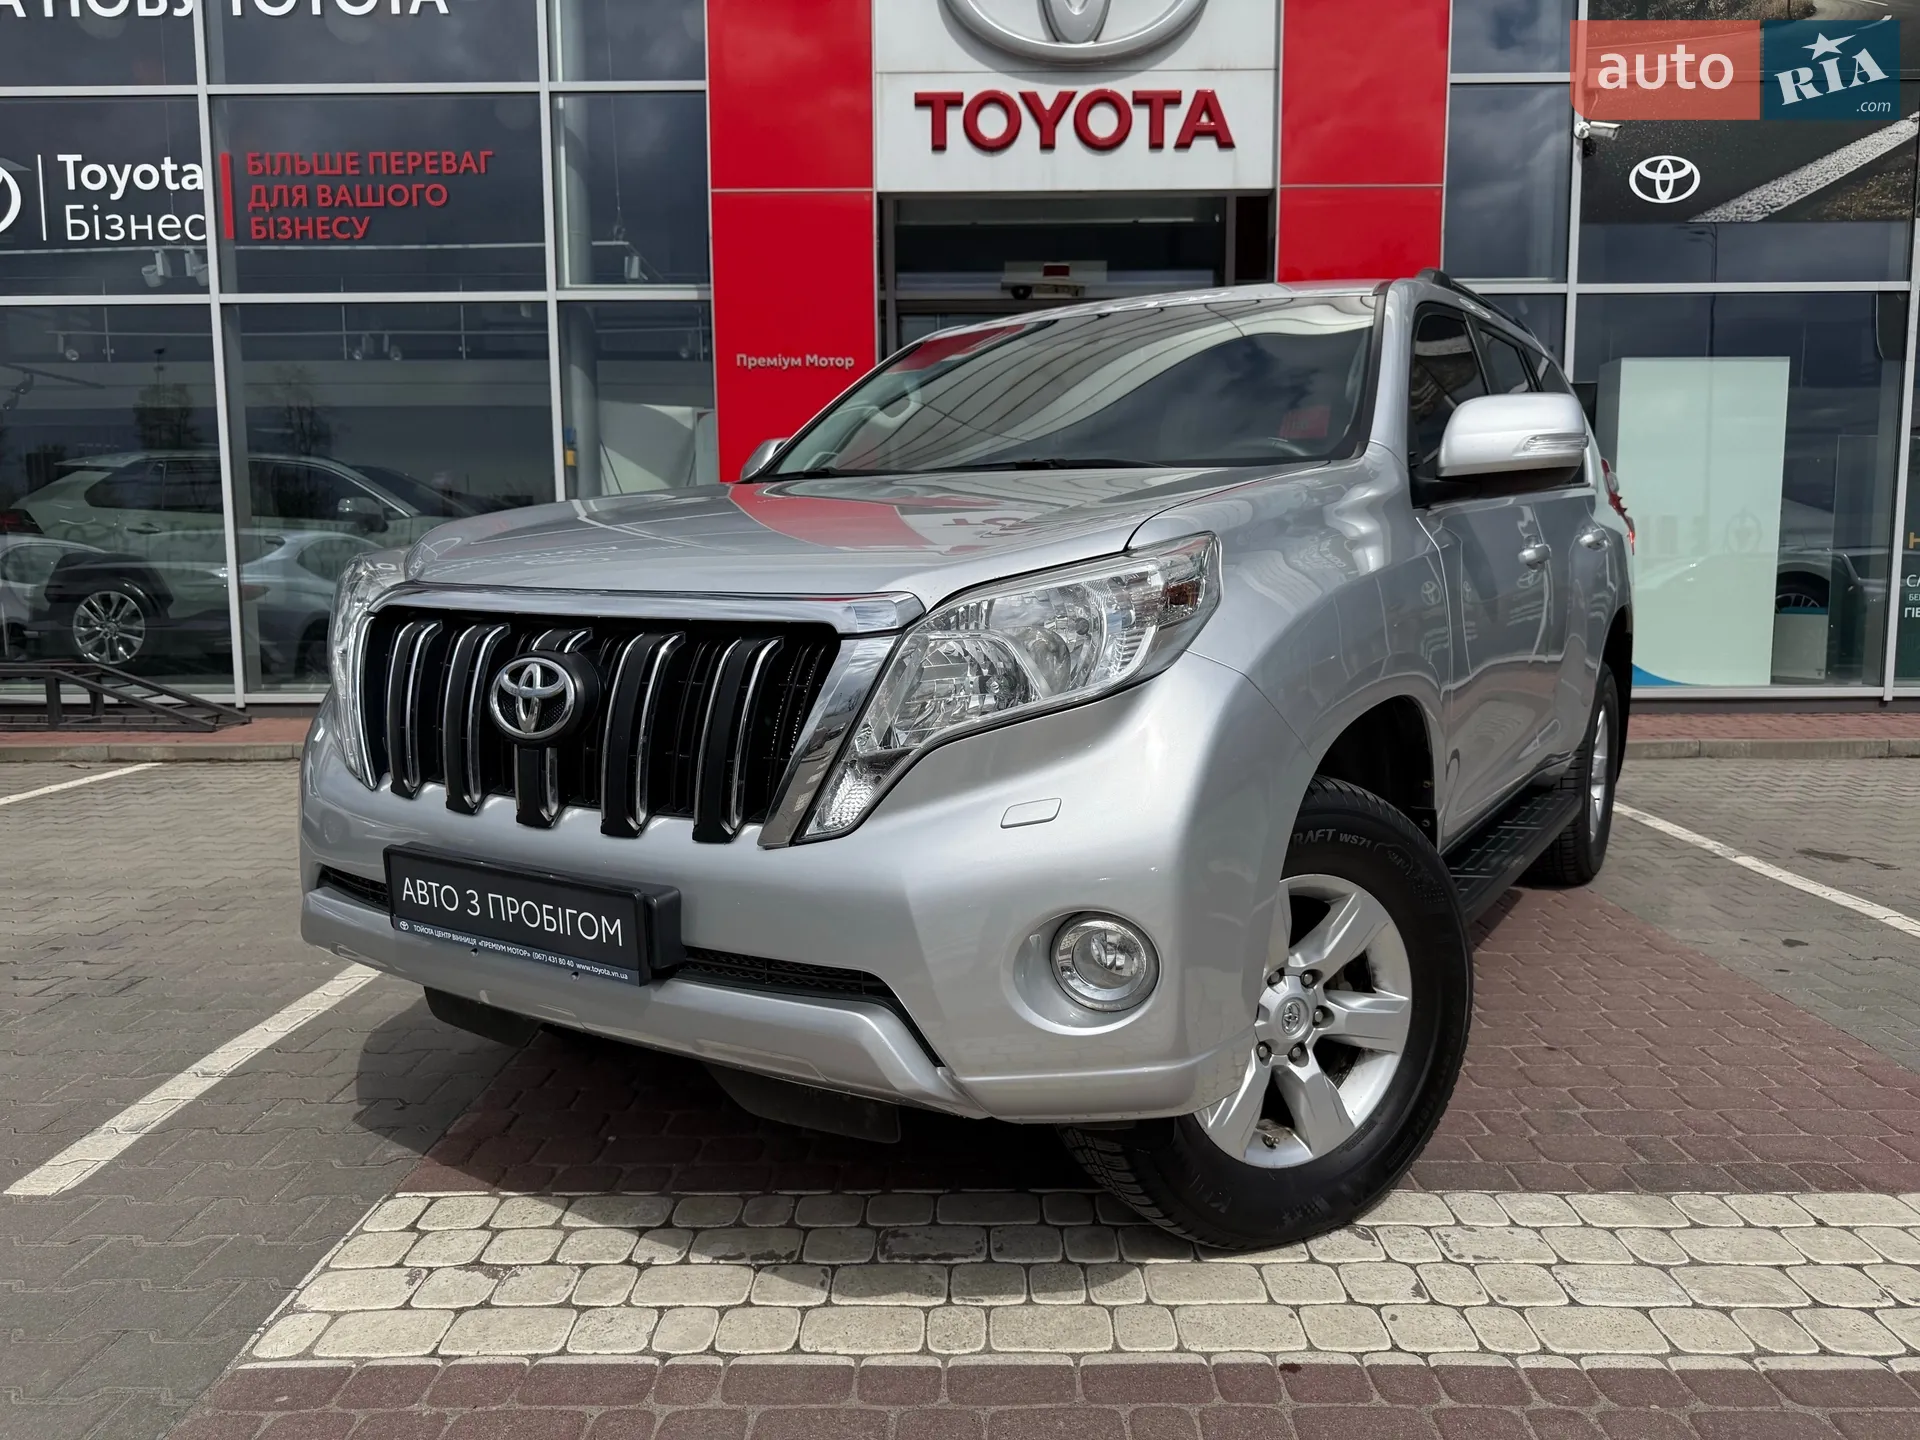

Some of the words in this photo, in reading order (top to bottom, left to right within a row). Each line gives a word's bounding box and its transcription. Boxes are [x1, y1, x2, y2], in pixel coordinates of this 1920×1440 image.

[914, 89, 1236, 152] TOYOTA
[57, 154, 204, 200] Toyota
[246, 151, 361, 176] БІЛЬШЕ
[368, 150, 493, 175] ПЕРЕВАГ
[248, 184, 309, 212] ДЛЯ
[316, 183, 448, 208] ВАШОГО
[65, 204, 207, 241] Бізнес
[250, 216, 370, 240] БІЗНЕСУ
[736, 353, 802, 371] Преміум
[805, 353, 855, 370] Мотор
[1339, 831, 1372, 848] WS71
[402, 877, 459, 912] АВТО
[465, 889, 481, 916] З
[487, 893, 623, 947] ПРОБІГОМ
[434, 930, 452, 940] ЦЕНТР
[452, 934, 477, 946] ВІННИЦЯ
[532, 951, 548, 962] (067)
[548, 955, 558, 964] 431
[576, 962, 629, 980] www.toyota.vn.ua
